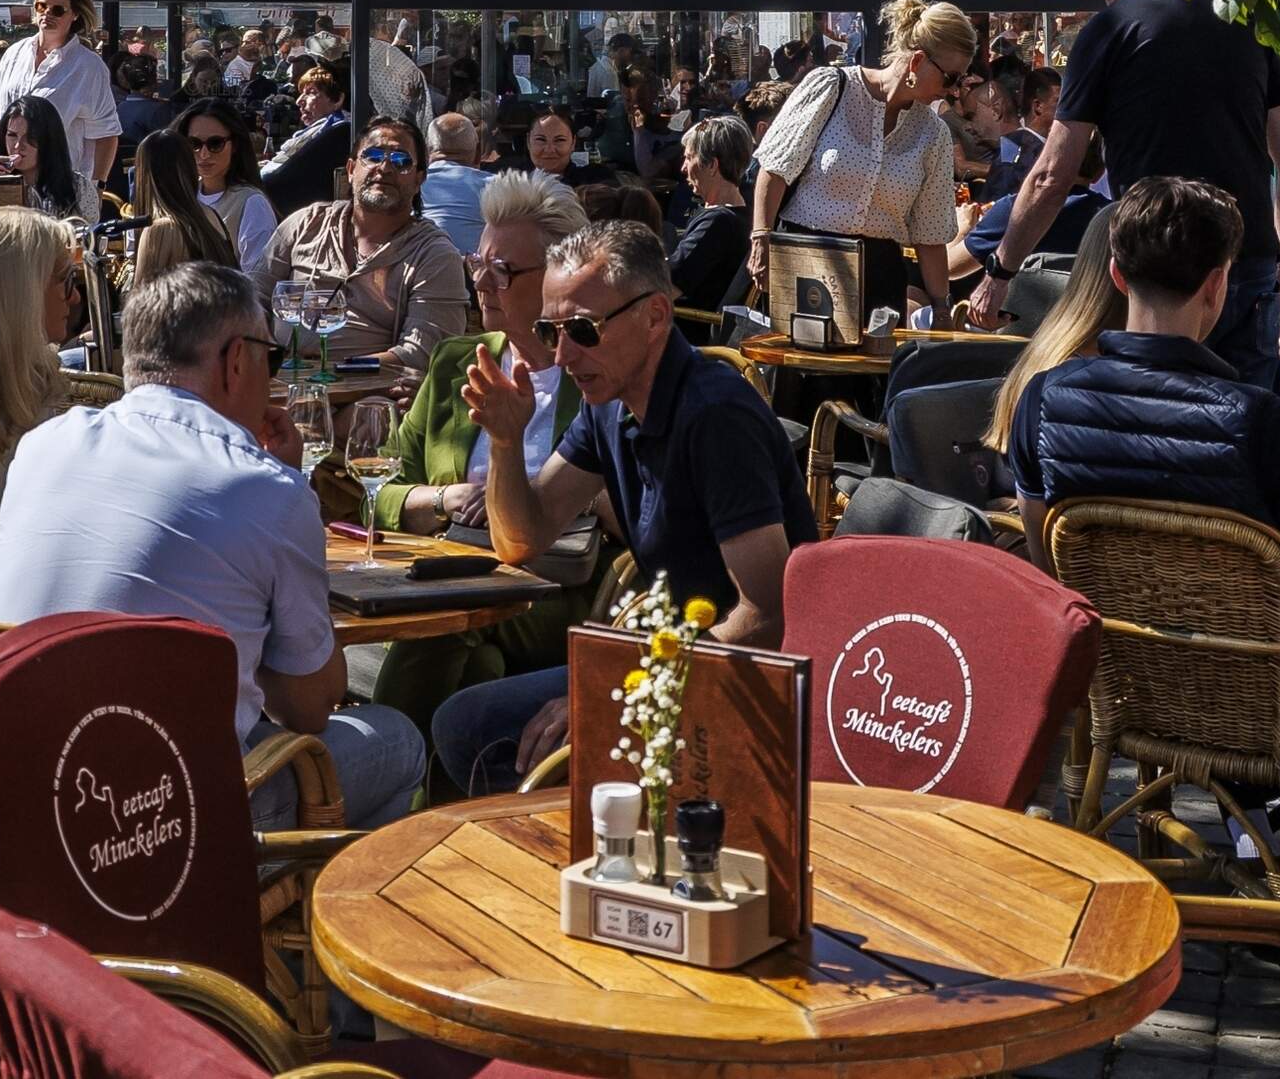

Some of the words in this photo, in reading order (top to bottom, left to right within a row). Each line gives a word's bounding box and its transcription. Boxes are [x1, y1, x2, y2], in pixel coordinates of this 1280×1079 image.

[892, 695, 953, 726] eetcafé
[842, 708, 944, 758] Minckelers
[122, 774, 174, 817] eetcafé
[89, 815, 183, 873] Minckelers
[653, 921, 674, 939] 67
